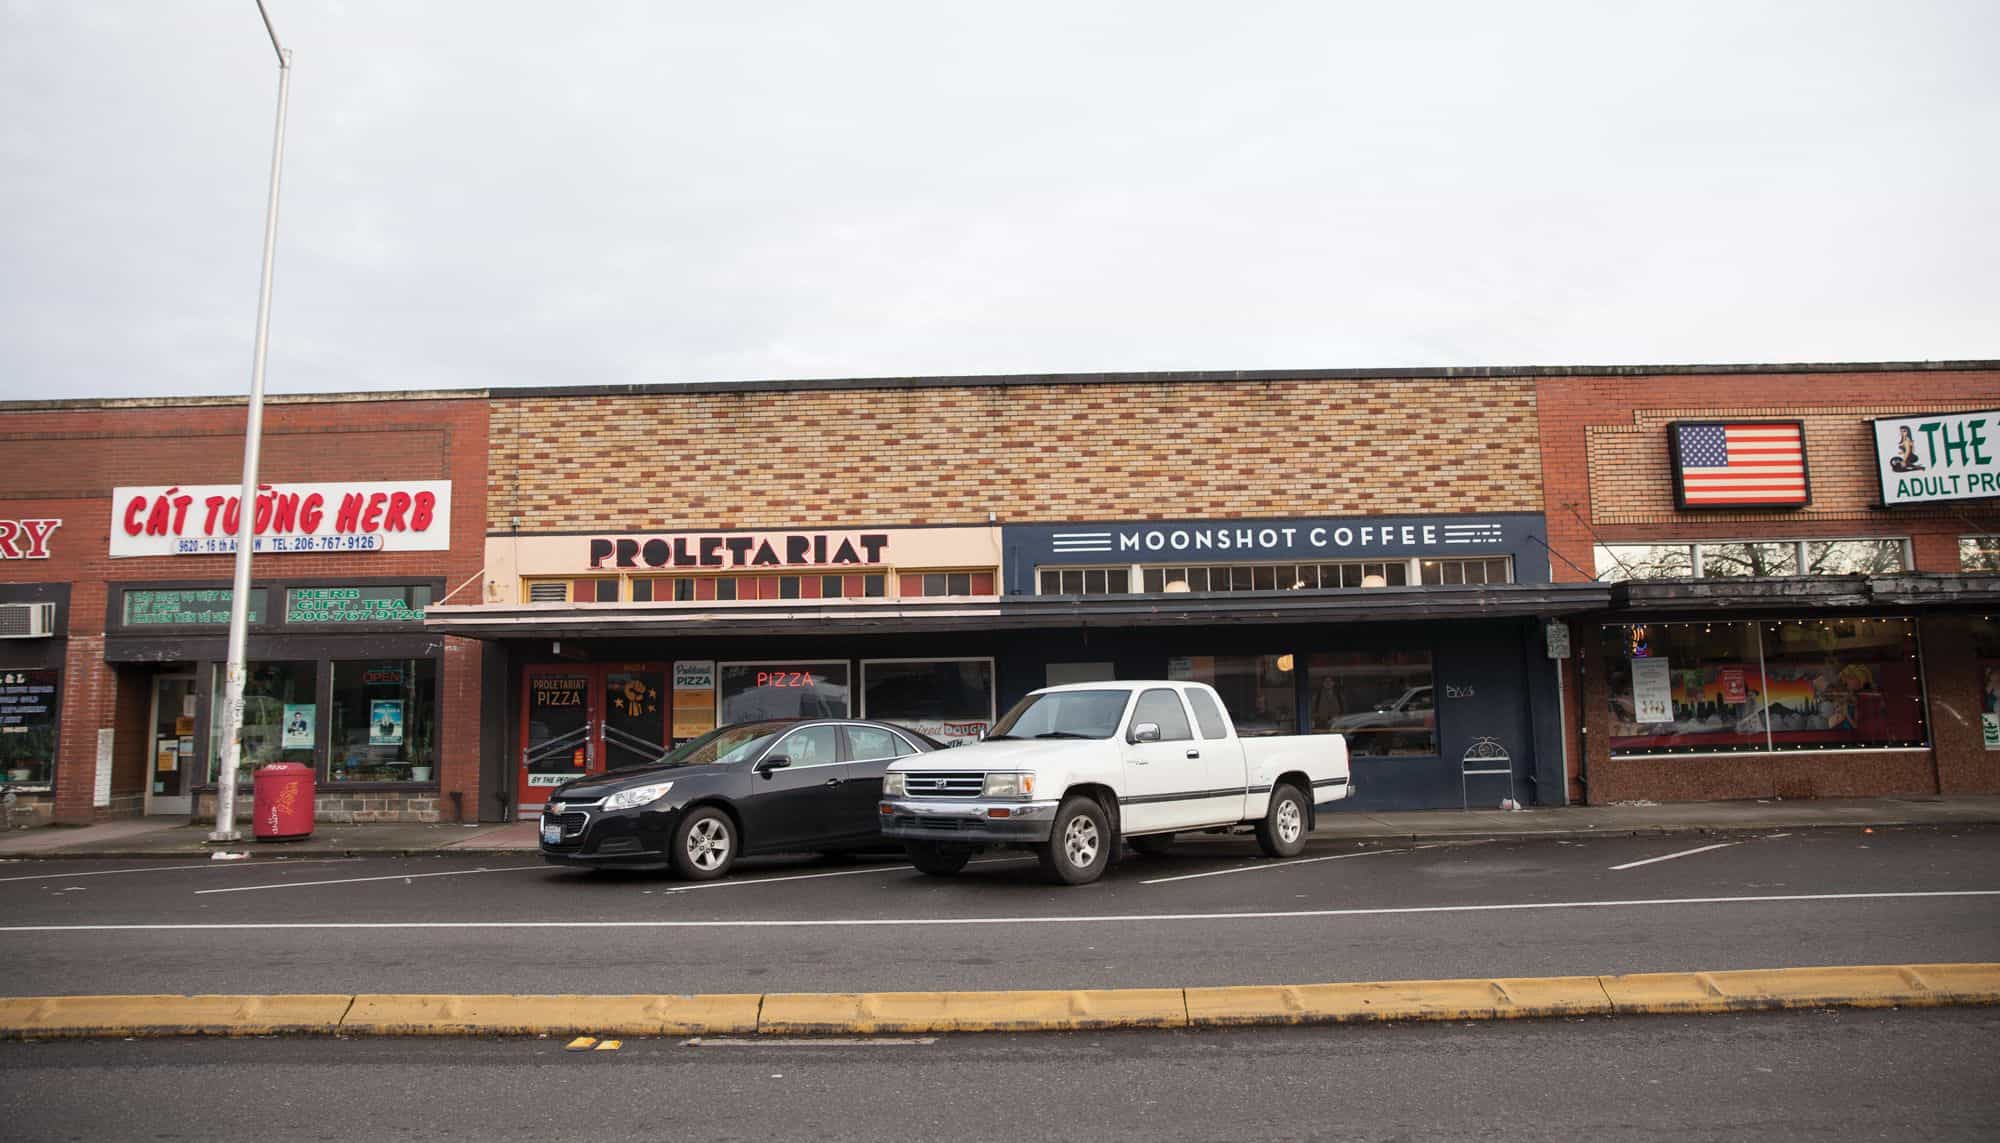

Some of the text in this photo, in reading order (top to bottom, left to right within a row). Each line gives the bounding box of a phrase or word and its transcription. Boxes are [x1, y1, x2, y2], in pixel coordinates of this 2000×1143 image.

[1919, 419, 1993, 468] THE
[1896, 475, 1961, 498] ADULT
[335, 490, 436, 534] HERB
[1120, 525, 1438, 551] MOONSHOT COFFEE
[589, 533, 888, 569] PROLETARIAT
[296, 589, 360, 600] HERB
[297, 599, 408, 610] GIFT TEA
[362, 671, 402, 681] OPEN
[676, 675, 712, 686] PIZZA
[756, 671, 815, 688] PIZZA
[533, 679, 586, 690] PROLETARIAT
[537, 691, 581, 706] PIZZA
